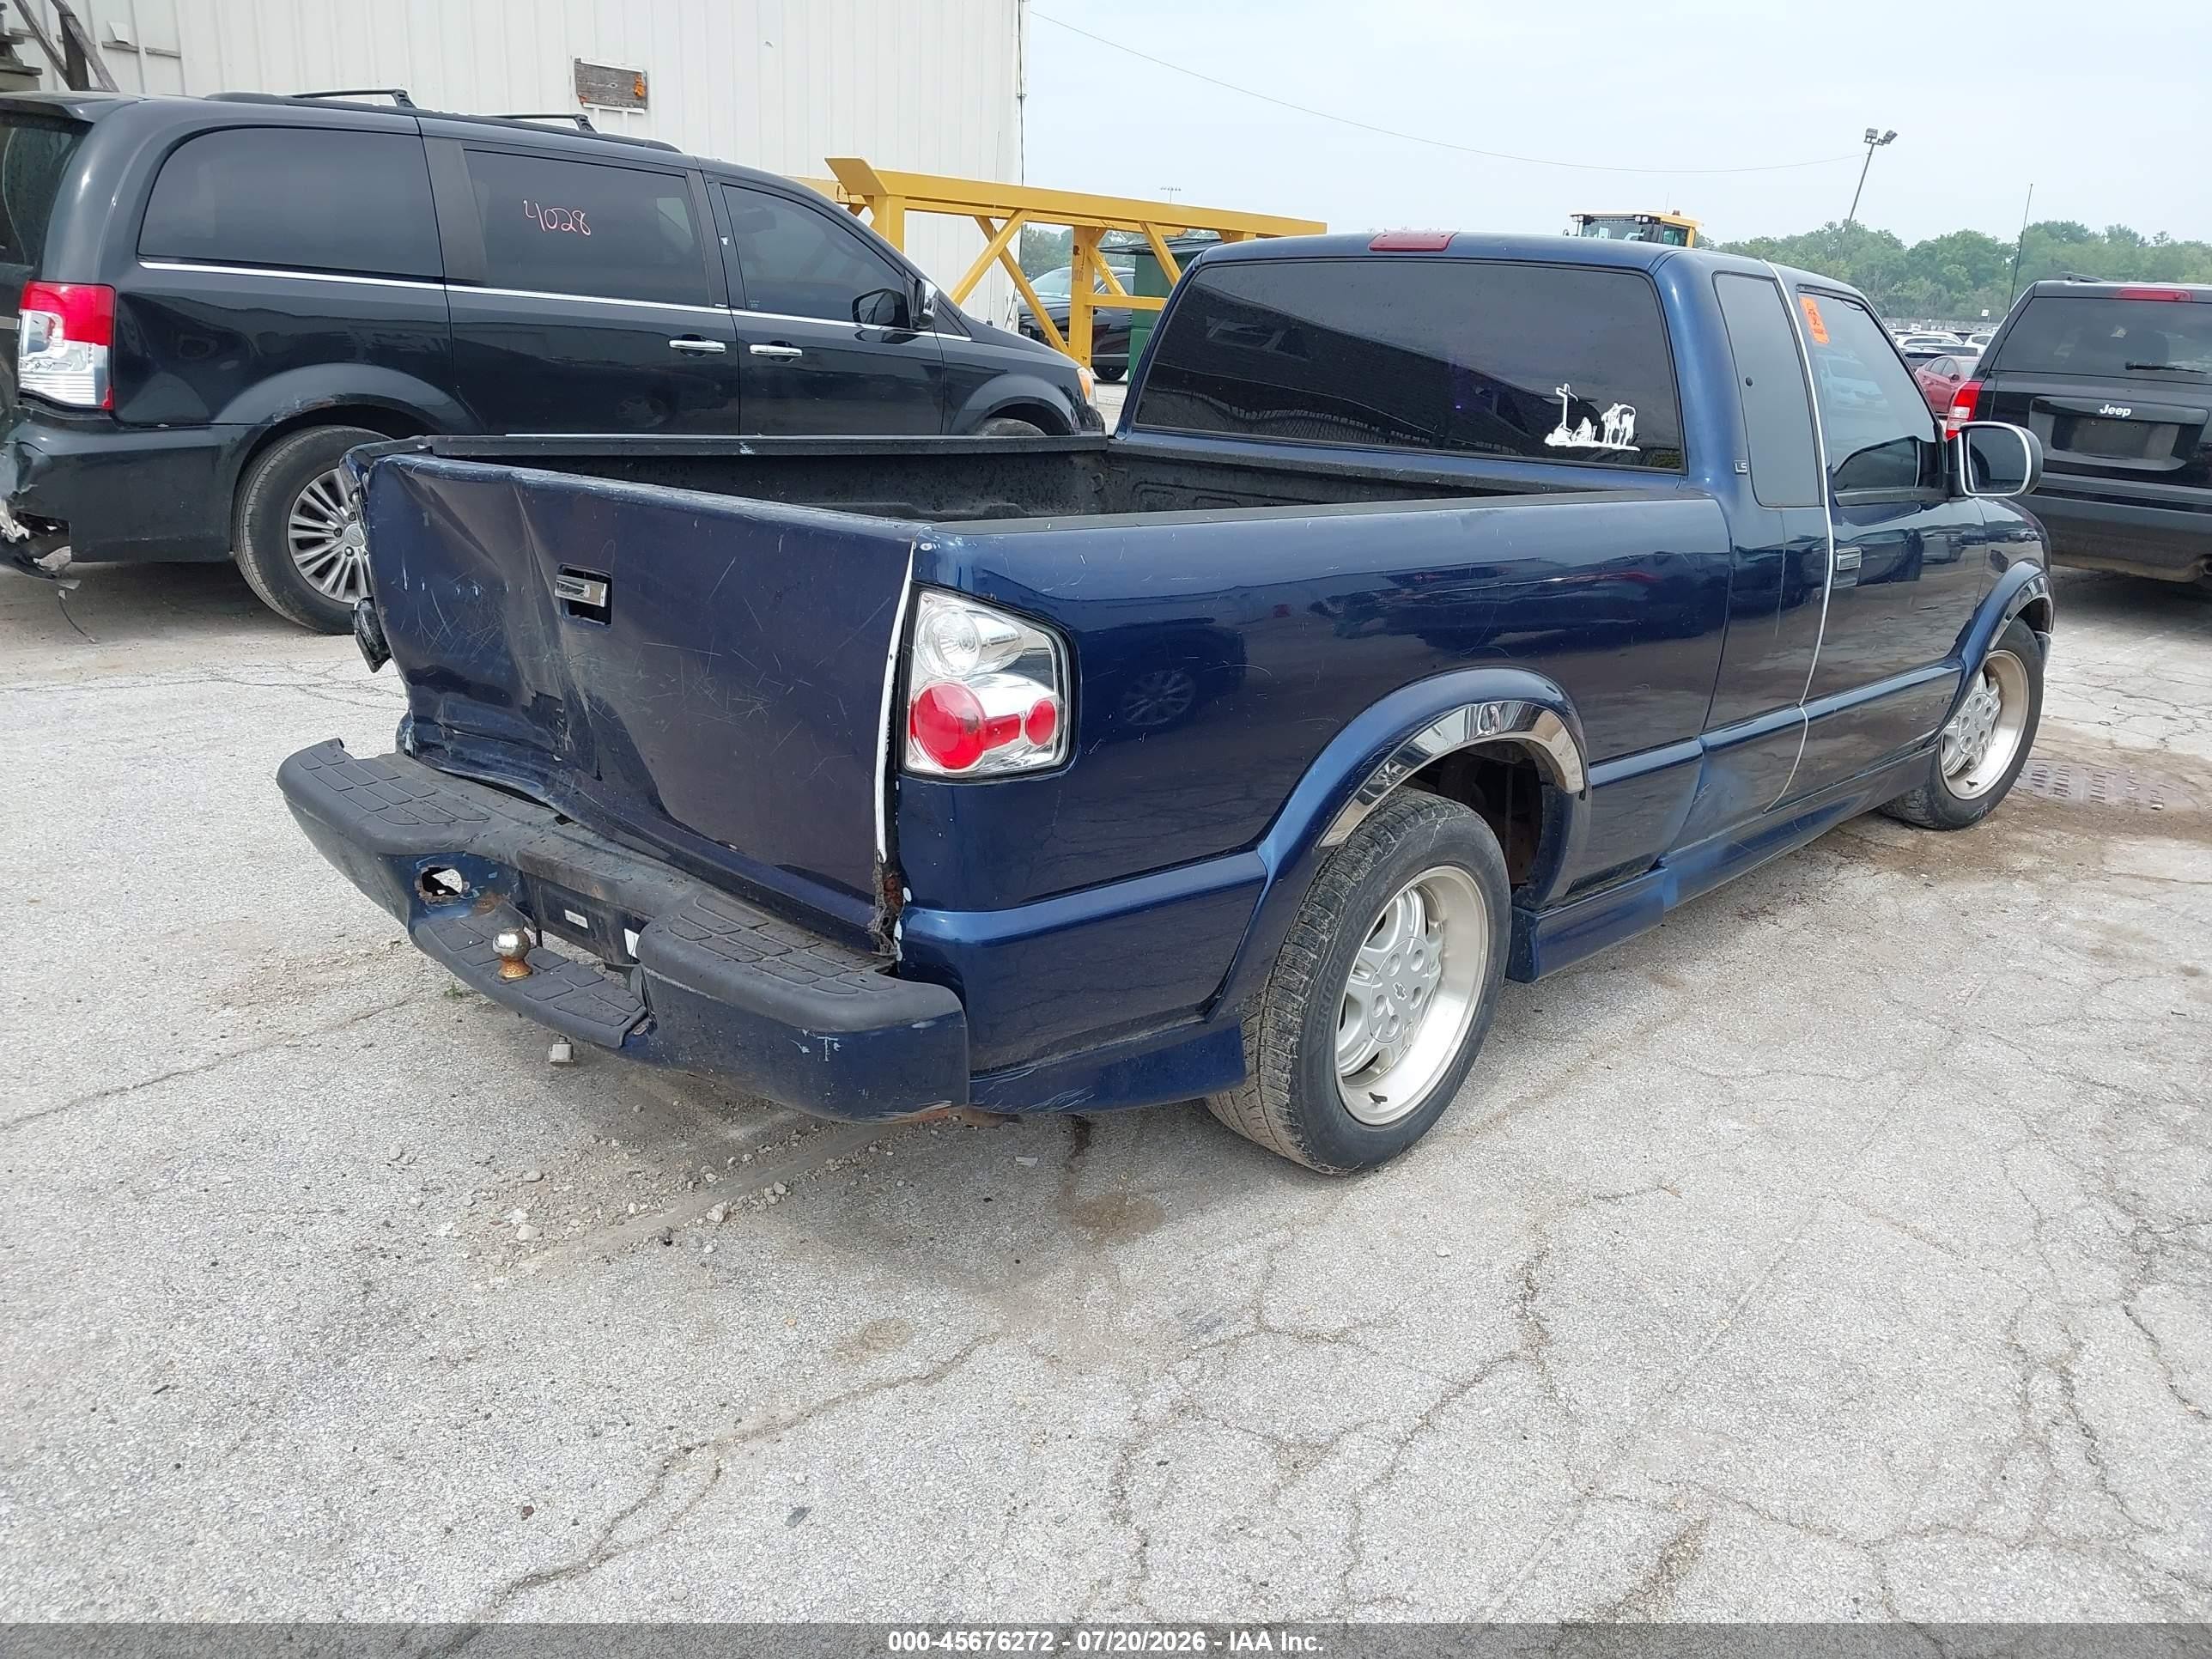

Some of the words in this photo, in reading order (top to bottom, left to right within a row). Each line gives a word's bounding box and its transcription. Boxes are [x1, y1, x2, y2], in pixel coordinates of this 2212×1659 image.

[523, 199, 591, 236] 4028
[2099, 404, 2132, 418] Jeep
[1735, 462, 1747, 473] LS
